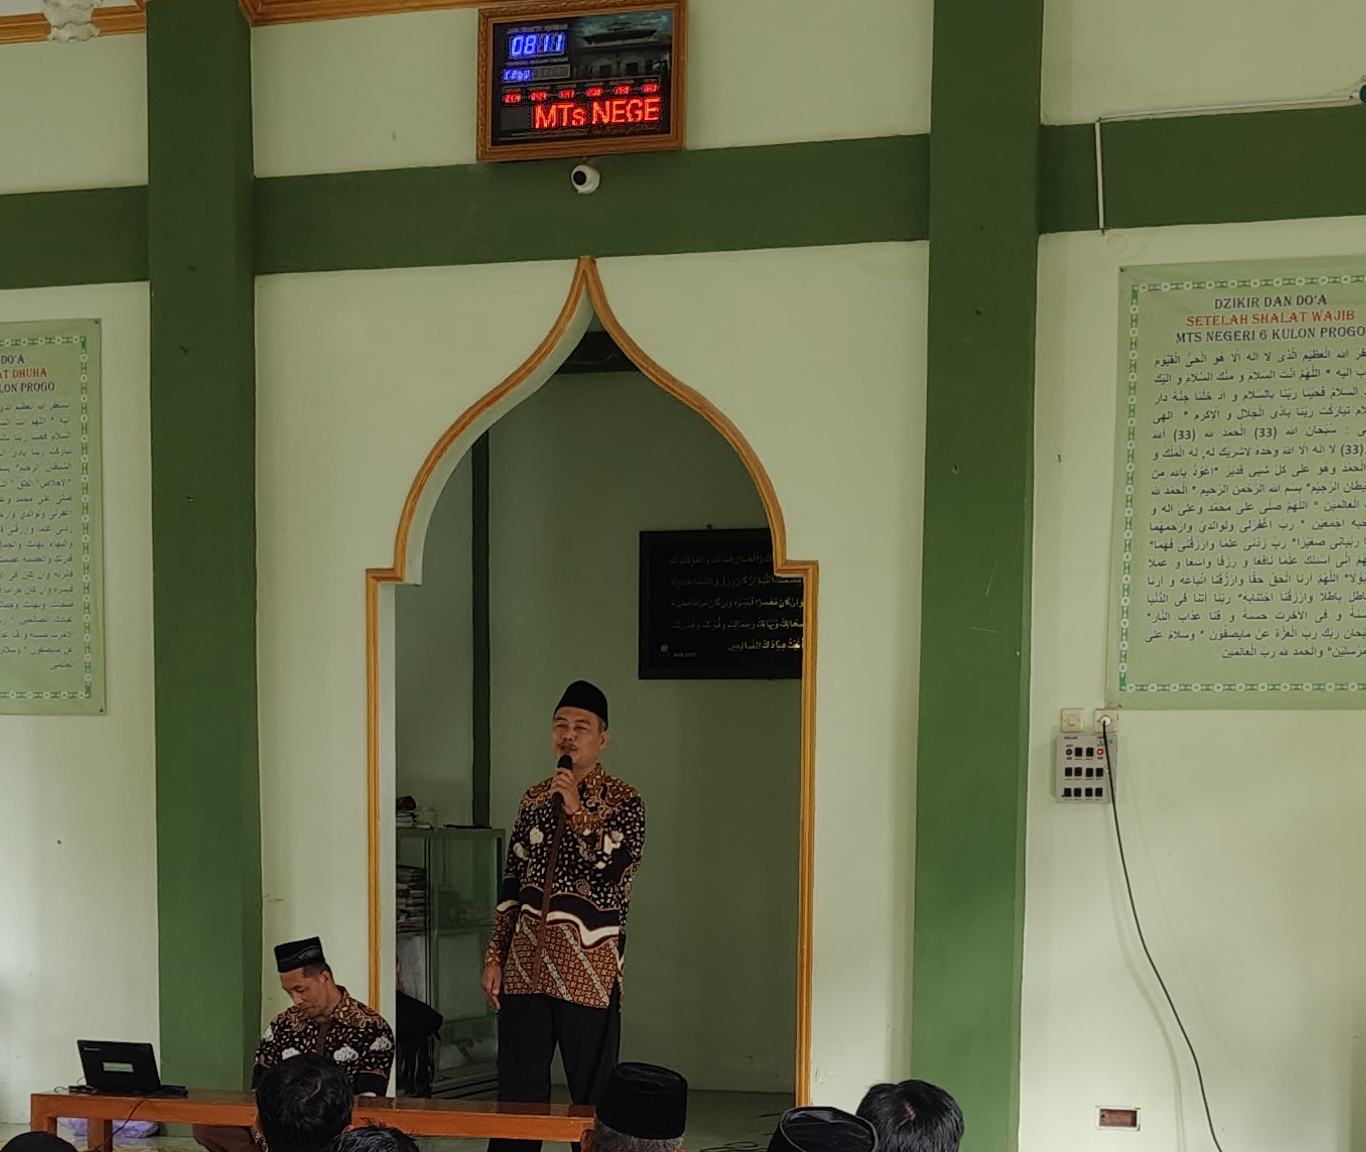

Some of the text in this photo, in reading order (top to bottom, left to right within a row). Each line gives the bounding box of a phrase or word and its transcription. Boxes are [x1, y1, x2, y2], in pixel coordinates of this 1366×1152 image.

[535, 97, 660, 128] MTs NEGE
[1215, 298, 1259, 310] DZIKIR
[1265, 296, 1292, 307] DAN
[1187, 310, 1355, 326] SETELAH SHALAT WAJIB
[1176, 326, 1366, 343] MTS NEGERI 6 KULON PROGO
[13, 368, 47, 378] DHUHA
[21, 382, 54, 391] PROGO
